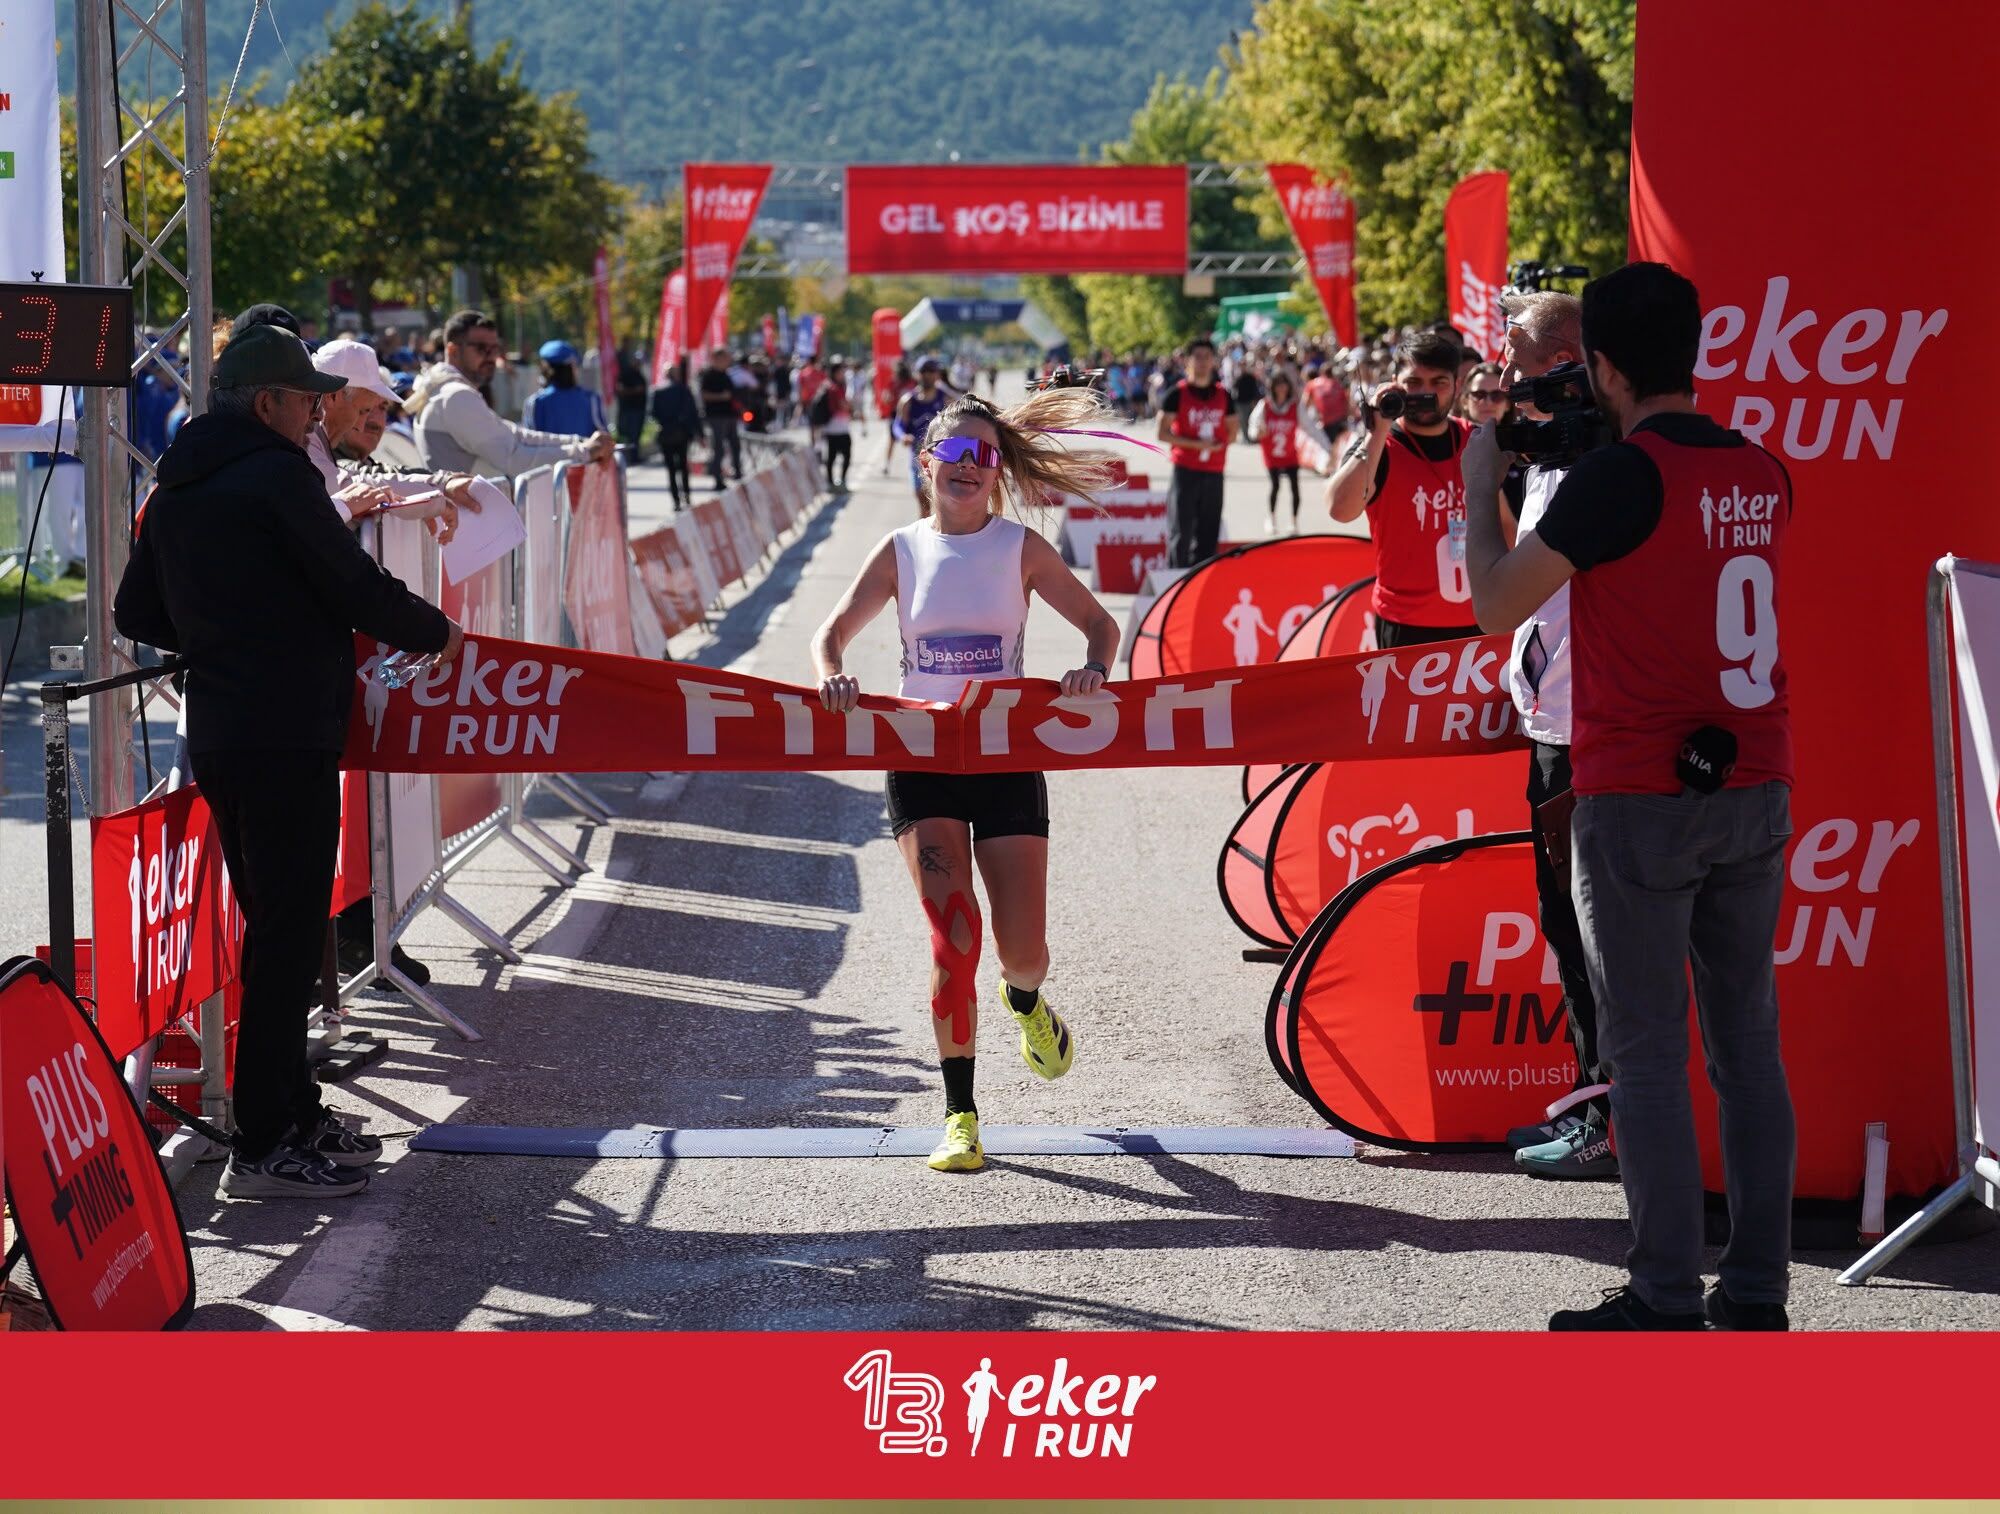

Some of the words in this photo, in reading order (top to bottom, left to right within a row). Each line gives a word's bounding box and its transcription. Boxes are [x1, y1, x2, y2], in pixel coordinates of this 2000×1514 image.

[880, 203, 944, 234] GEL
[953, 200, 1029, 236] KOŞ
[1038, 196, 1163, 232] BİZİMLE
[1692, 275, 1949, 385] eker
[0, 386, 30, 401] TTER
[1728, 396, 1904, 461] RUN
[1718, 485, 1779, 523] eker
[1719, 526, 1725, 549] I
[1733, 523, 1772, 547] RUN
[1716, 554, 1778, 709] 9
[411, 640, 584, 707] eker
[1408, 641, 1512, 696] ek
[407, 715, 422, 754] I
[445, 714, 560, 755] RUN
[1405, 704, 1419, 743] I
[1441, 702, 1530, 741] RU
[146, 823, 199, 925] eker
[1790, 818, 1921, 893] er
[147, 937, 152, 996] I
[156, 915, 192, 990] RUN
[1435, 1060, 1577, 1091] www.plusti
[26, 1042, 109, 1176] PLUS
